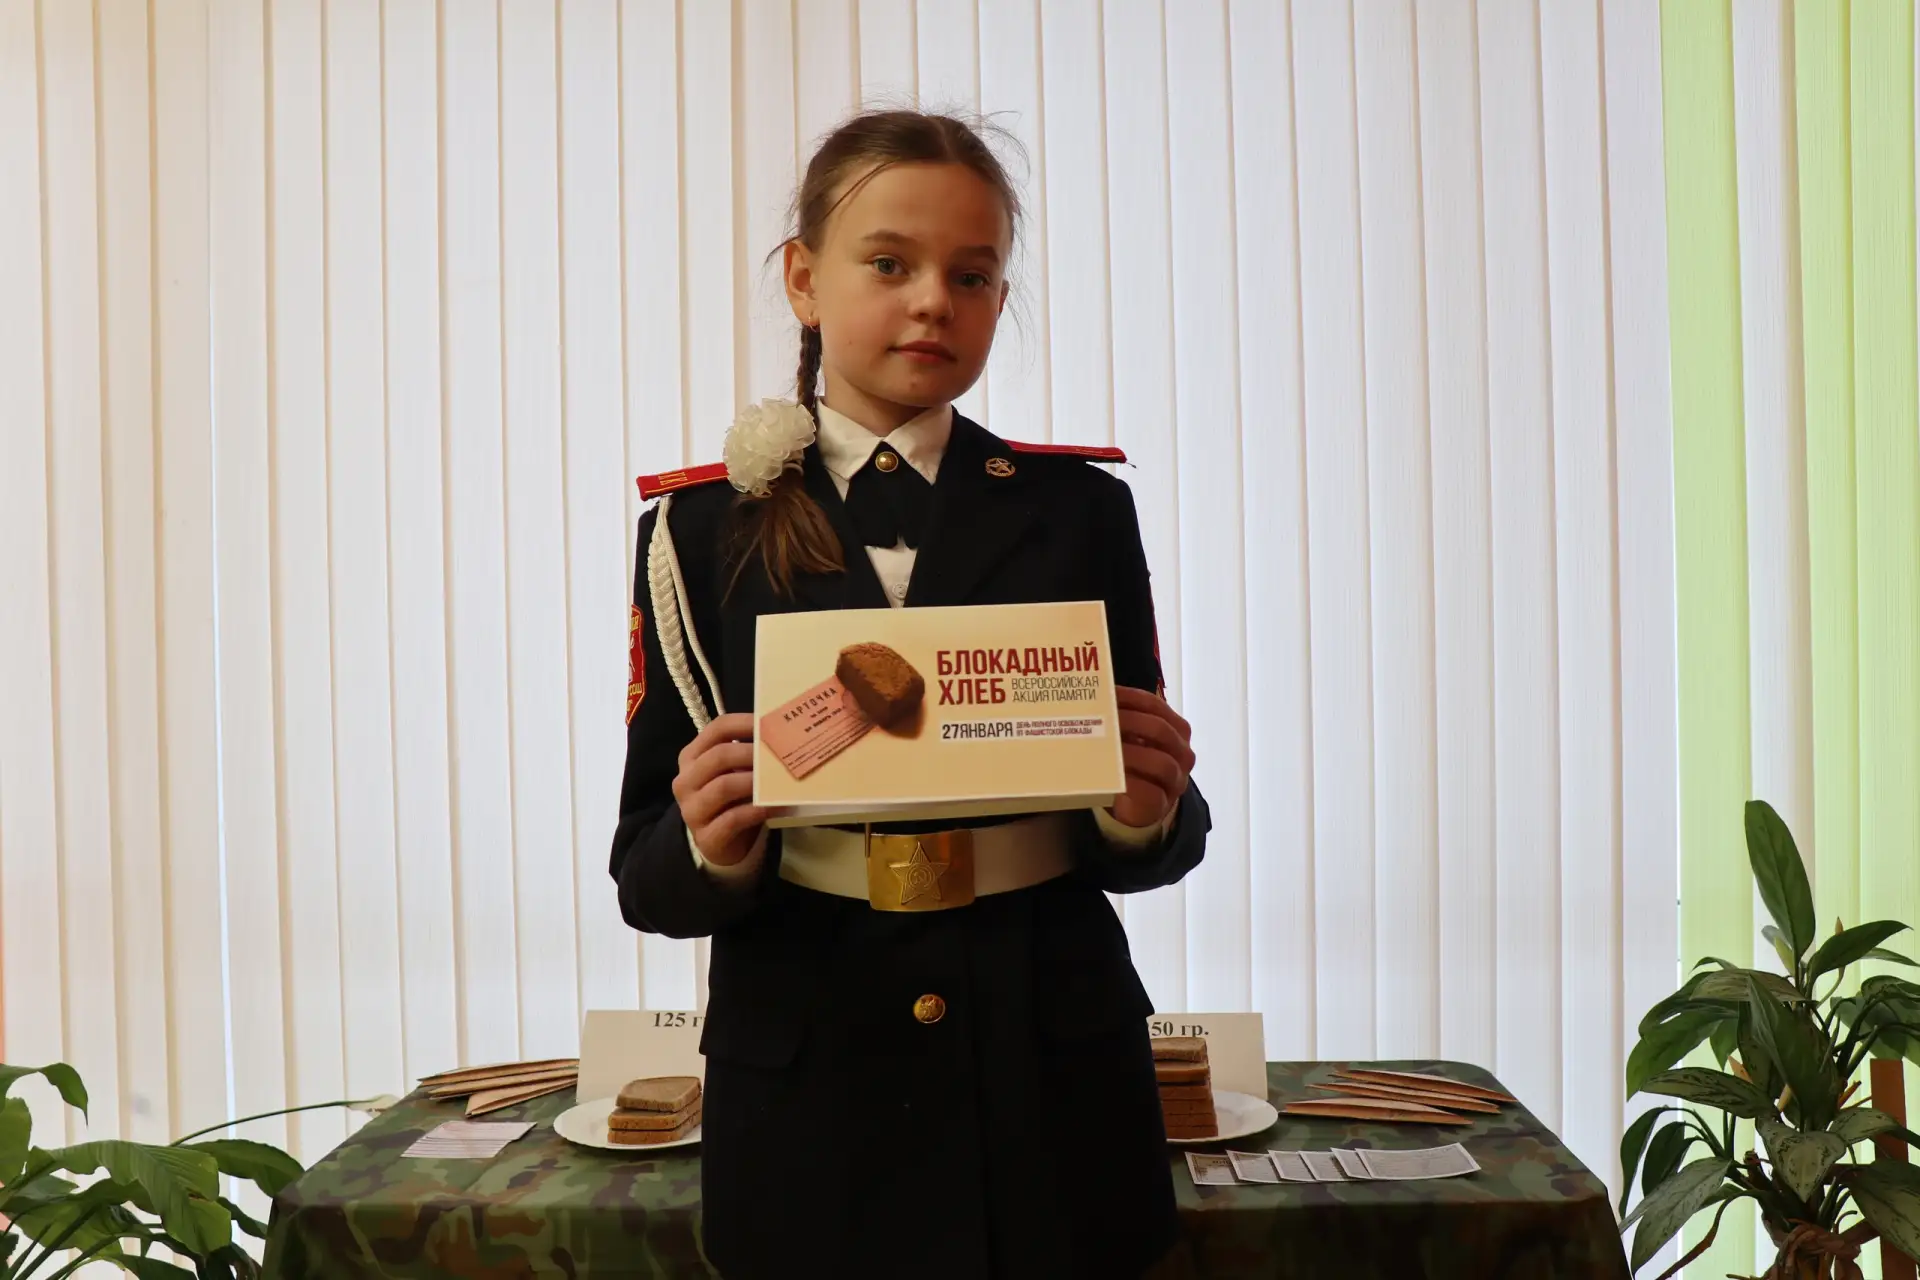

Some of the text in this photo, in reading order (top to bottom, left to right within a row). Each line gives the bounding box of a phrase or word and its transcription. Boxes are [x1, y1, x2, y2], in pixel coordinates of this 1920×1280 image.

[937, 641, 1099, 676] БЛОКАДНЫЙ
[1011, 675, 1099, 690] ВСЕРОССИЙСКАЯ
[938, 678, 1006, 705] ХЛЕБ
[1013, 688, 1096, 703] АКЦИЯ ПАМЯТИ
[783, 687, 837, 722] КАРТОЧКА
[653, 1012, 706, 1028] 125 г
[1147, 1021, 1209, 1038] 50 гр.
